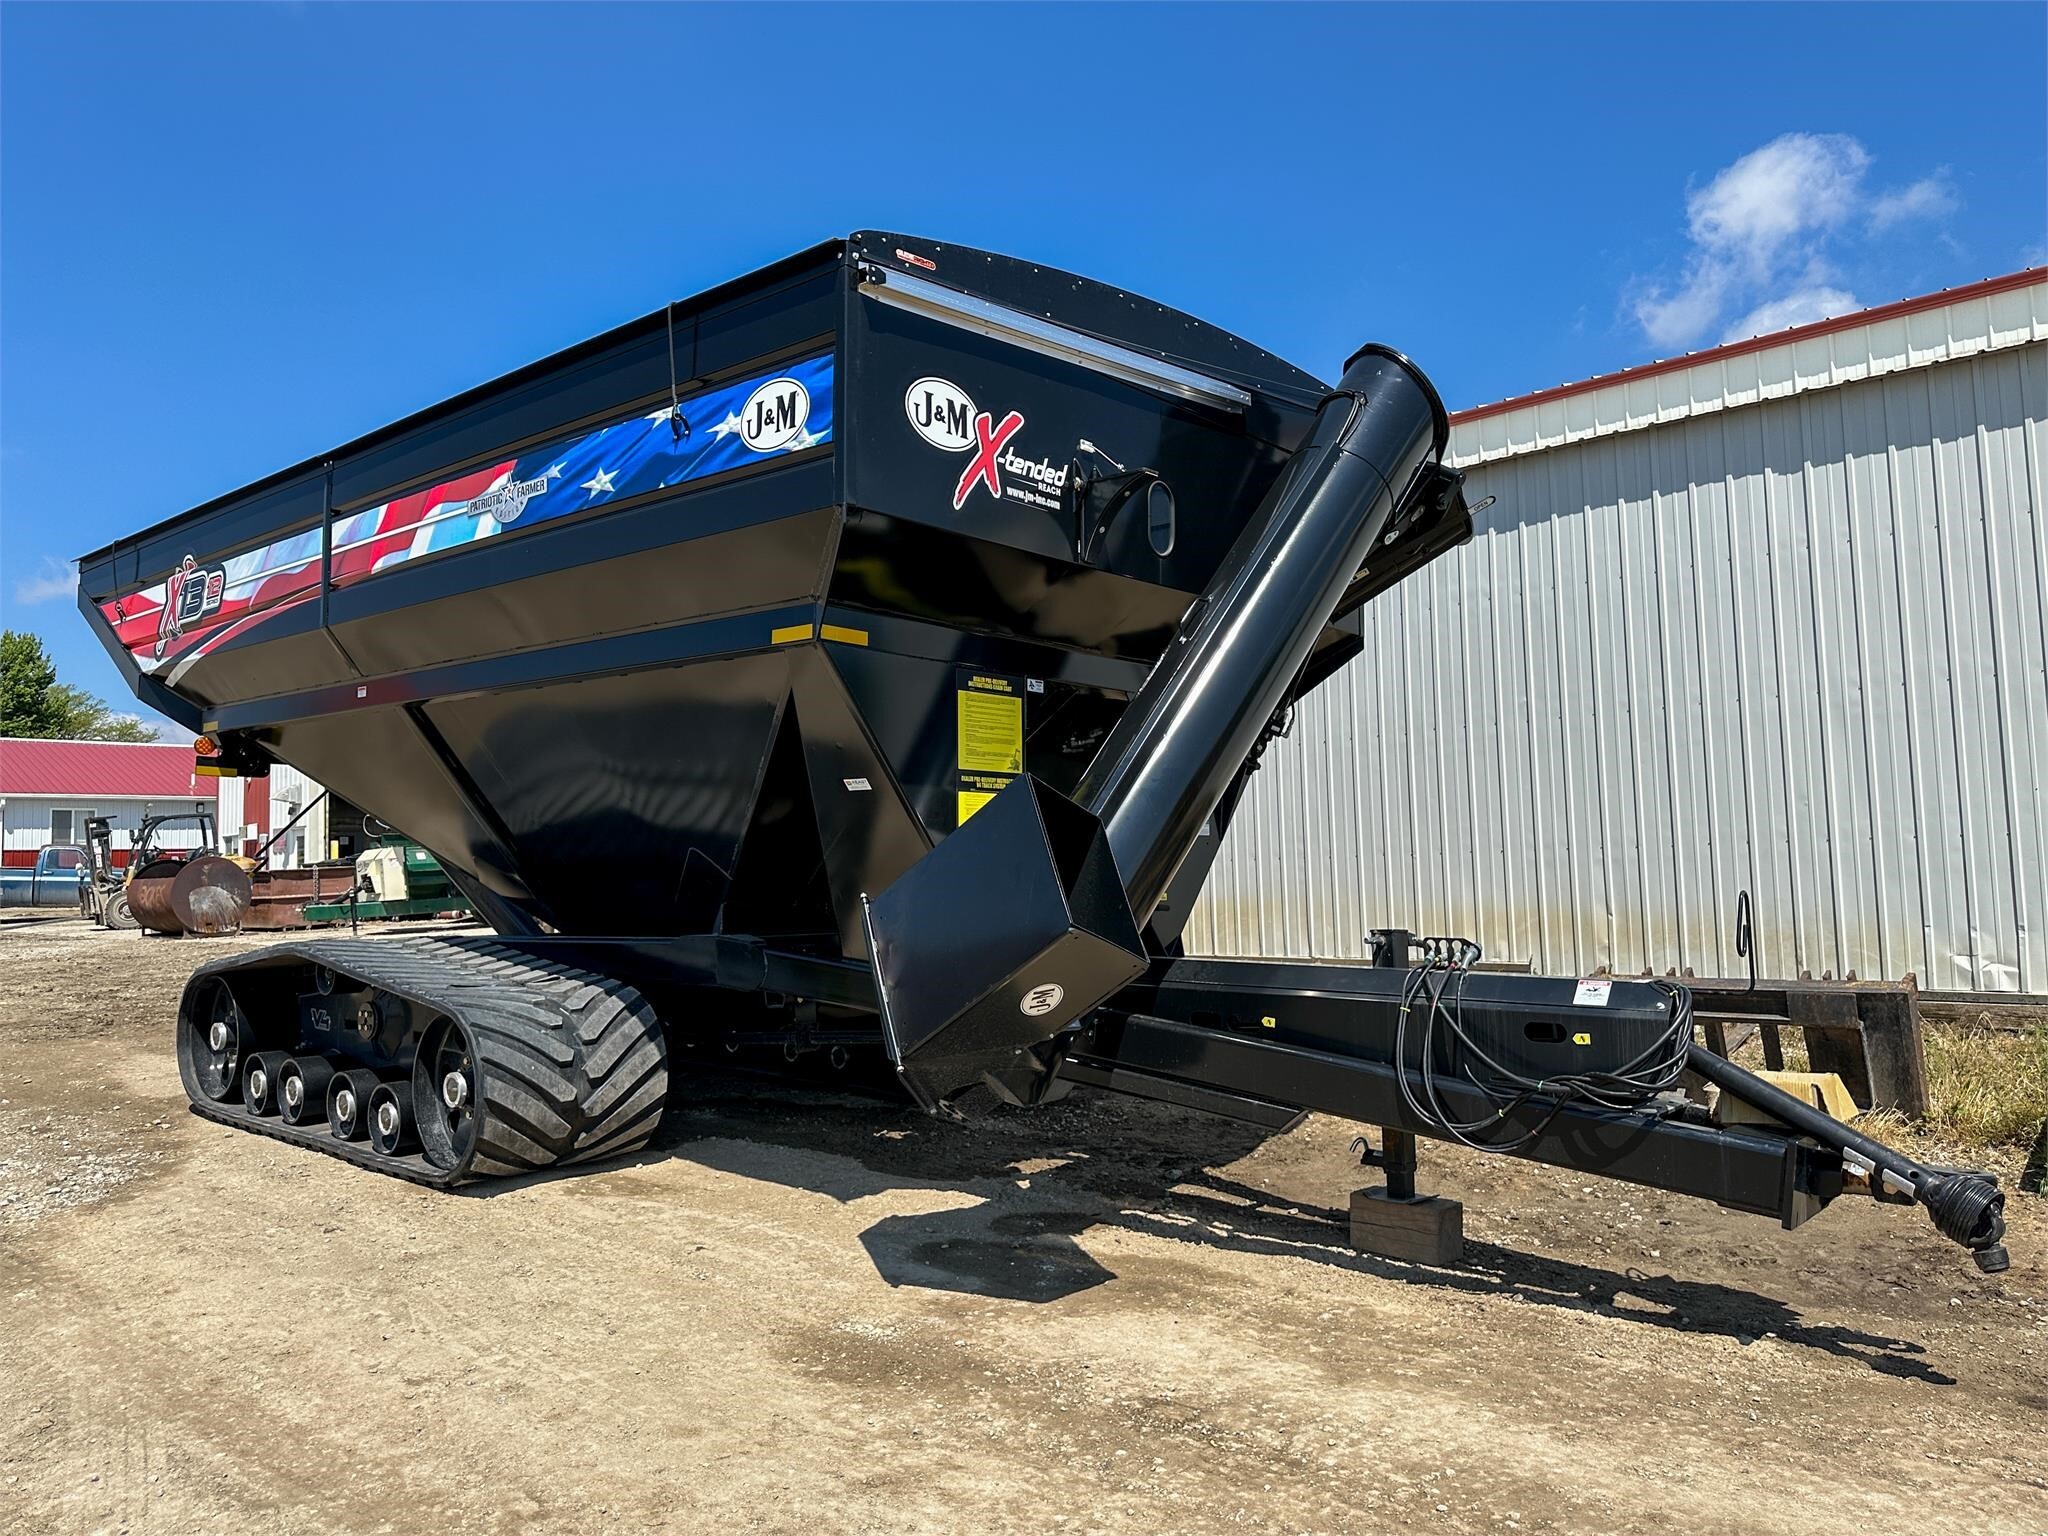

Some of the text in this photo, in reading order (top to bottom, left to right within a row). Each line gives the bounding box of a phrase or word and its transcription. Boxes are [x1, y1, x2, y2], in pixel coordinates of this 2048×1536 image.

[746, 390, 797, 440] J&M
[914, 390, 969, 440] J&M
[469, 479, 546, 512] PATRIOTIC FARMER
[1006, 486, 1061, 511] www.jm-inc.com
[1037, 482, 1062, 497] REACH
[1029, 987, 1056, 1012] J&M
